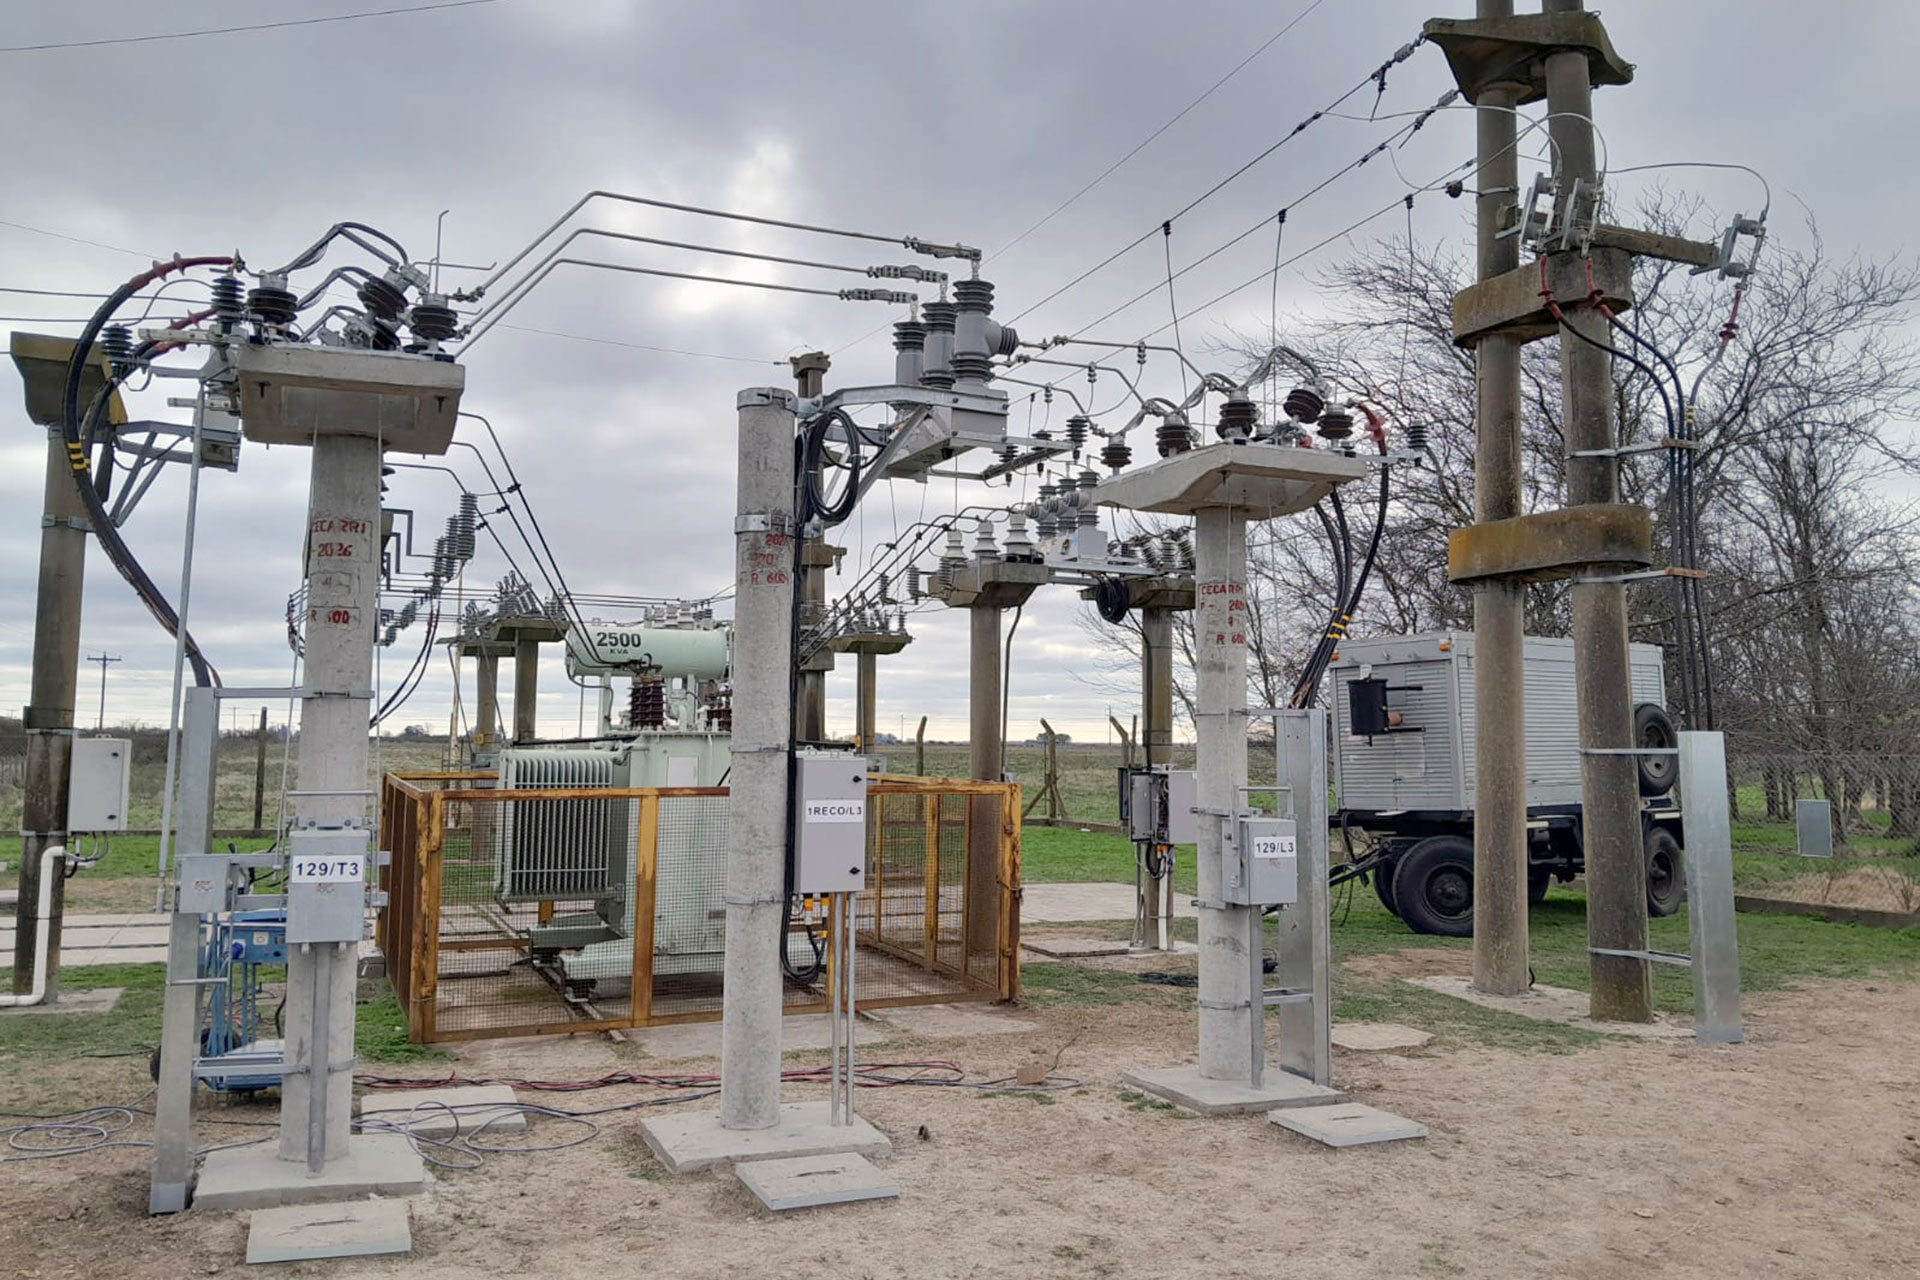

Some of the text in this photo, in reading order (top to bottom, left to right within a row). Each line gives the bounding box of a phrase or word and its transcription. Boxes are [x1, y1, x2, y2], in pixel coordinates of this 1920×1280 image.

[596, 632, 641, 648] 2500
[807, 806, 862, 816] 1RECO/L3
[1256, 842, 1295, 853] 129/L3
[296, 862, 359, 876] 129/T3
